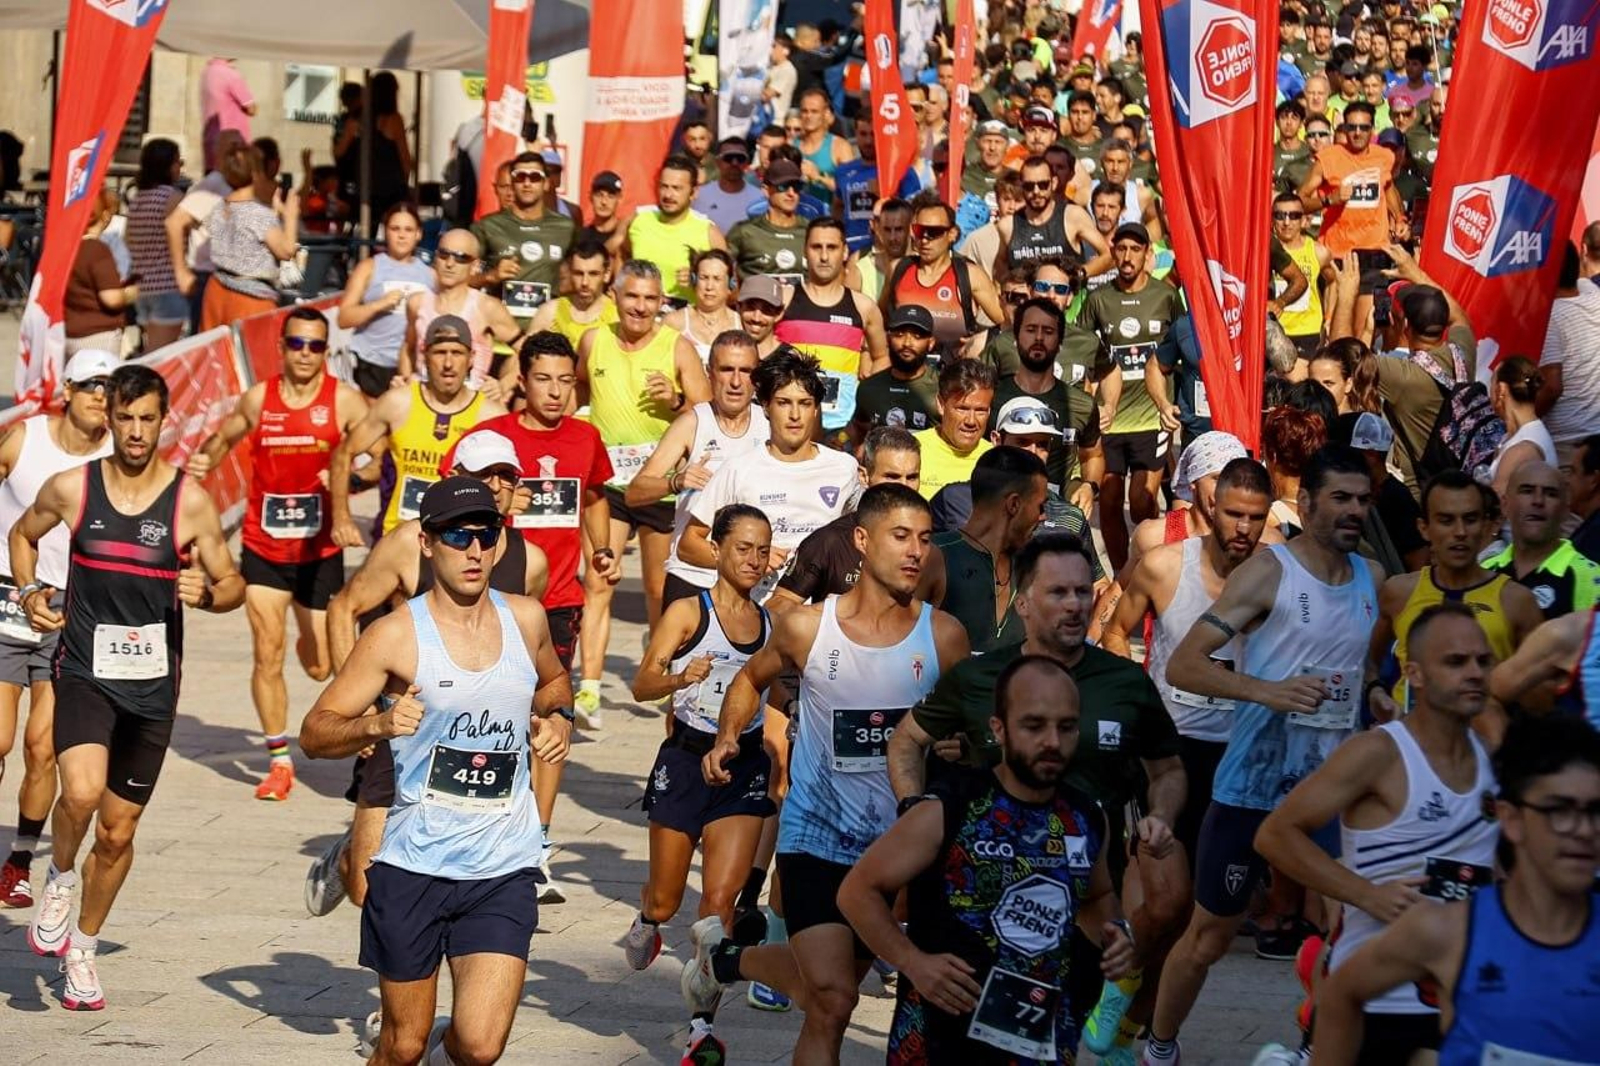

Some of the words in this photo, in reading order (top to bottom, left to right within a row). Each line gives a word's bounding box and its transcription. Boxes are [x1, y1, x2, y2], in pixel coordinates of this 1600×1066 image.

[1537, 24, 1588, 61] AXA
[1489, 231, 1542, 268] AXA
[531, 492, 564, 506] 351
[275, 507, 306, 521] 135
[109, 641, 153, 656] 1516
[828, 649, 841, 681] evelb
[452, 767, 497, 786] 419
[1440, 880, 1479, 901] 35
[1015, 1000, 1047, 1024] 77
